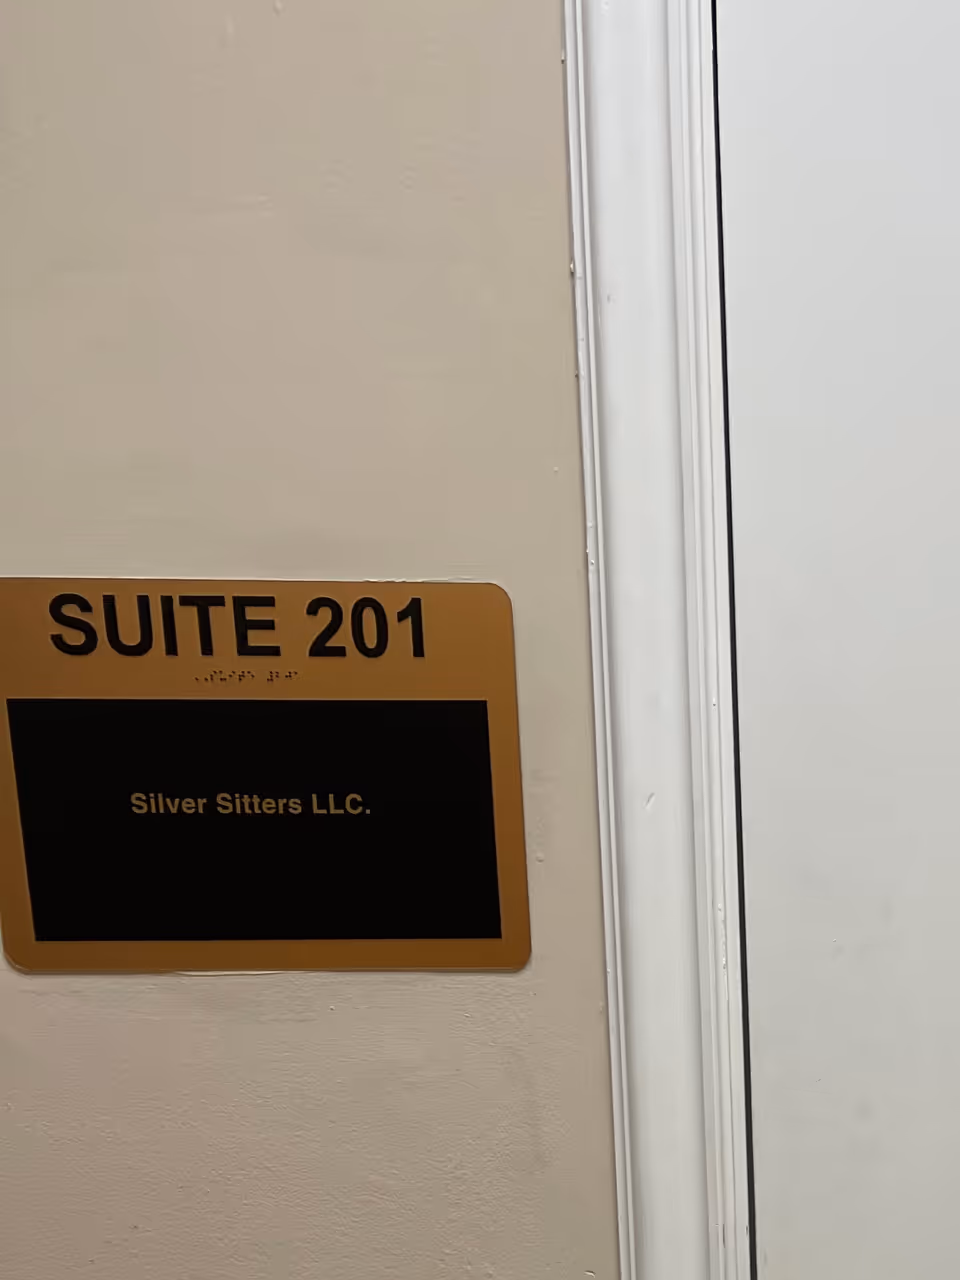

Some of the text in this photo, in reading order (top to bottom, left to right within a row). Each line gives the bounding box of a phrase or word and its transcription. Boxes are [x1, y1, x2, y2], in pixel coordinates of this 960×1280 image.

[48, 592, 426, 659] SUITE 201
[130, 792, 372, 815] Silver Sitters LLC.
